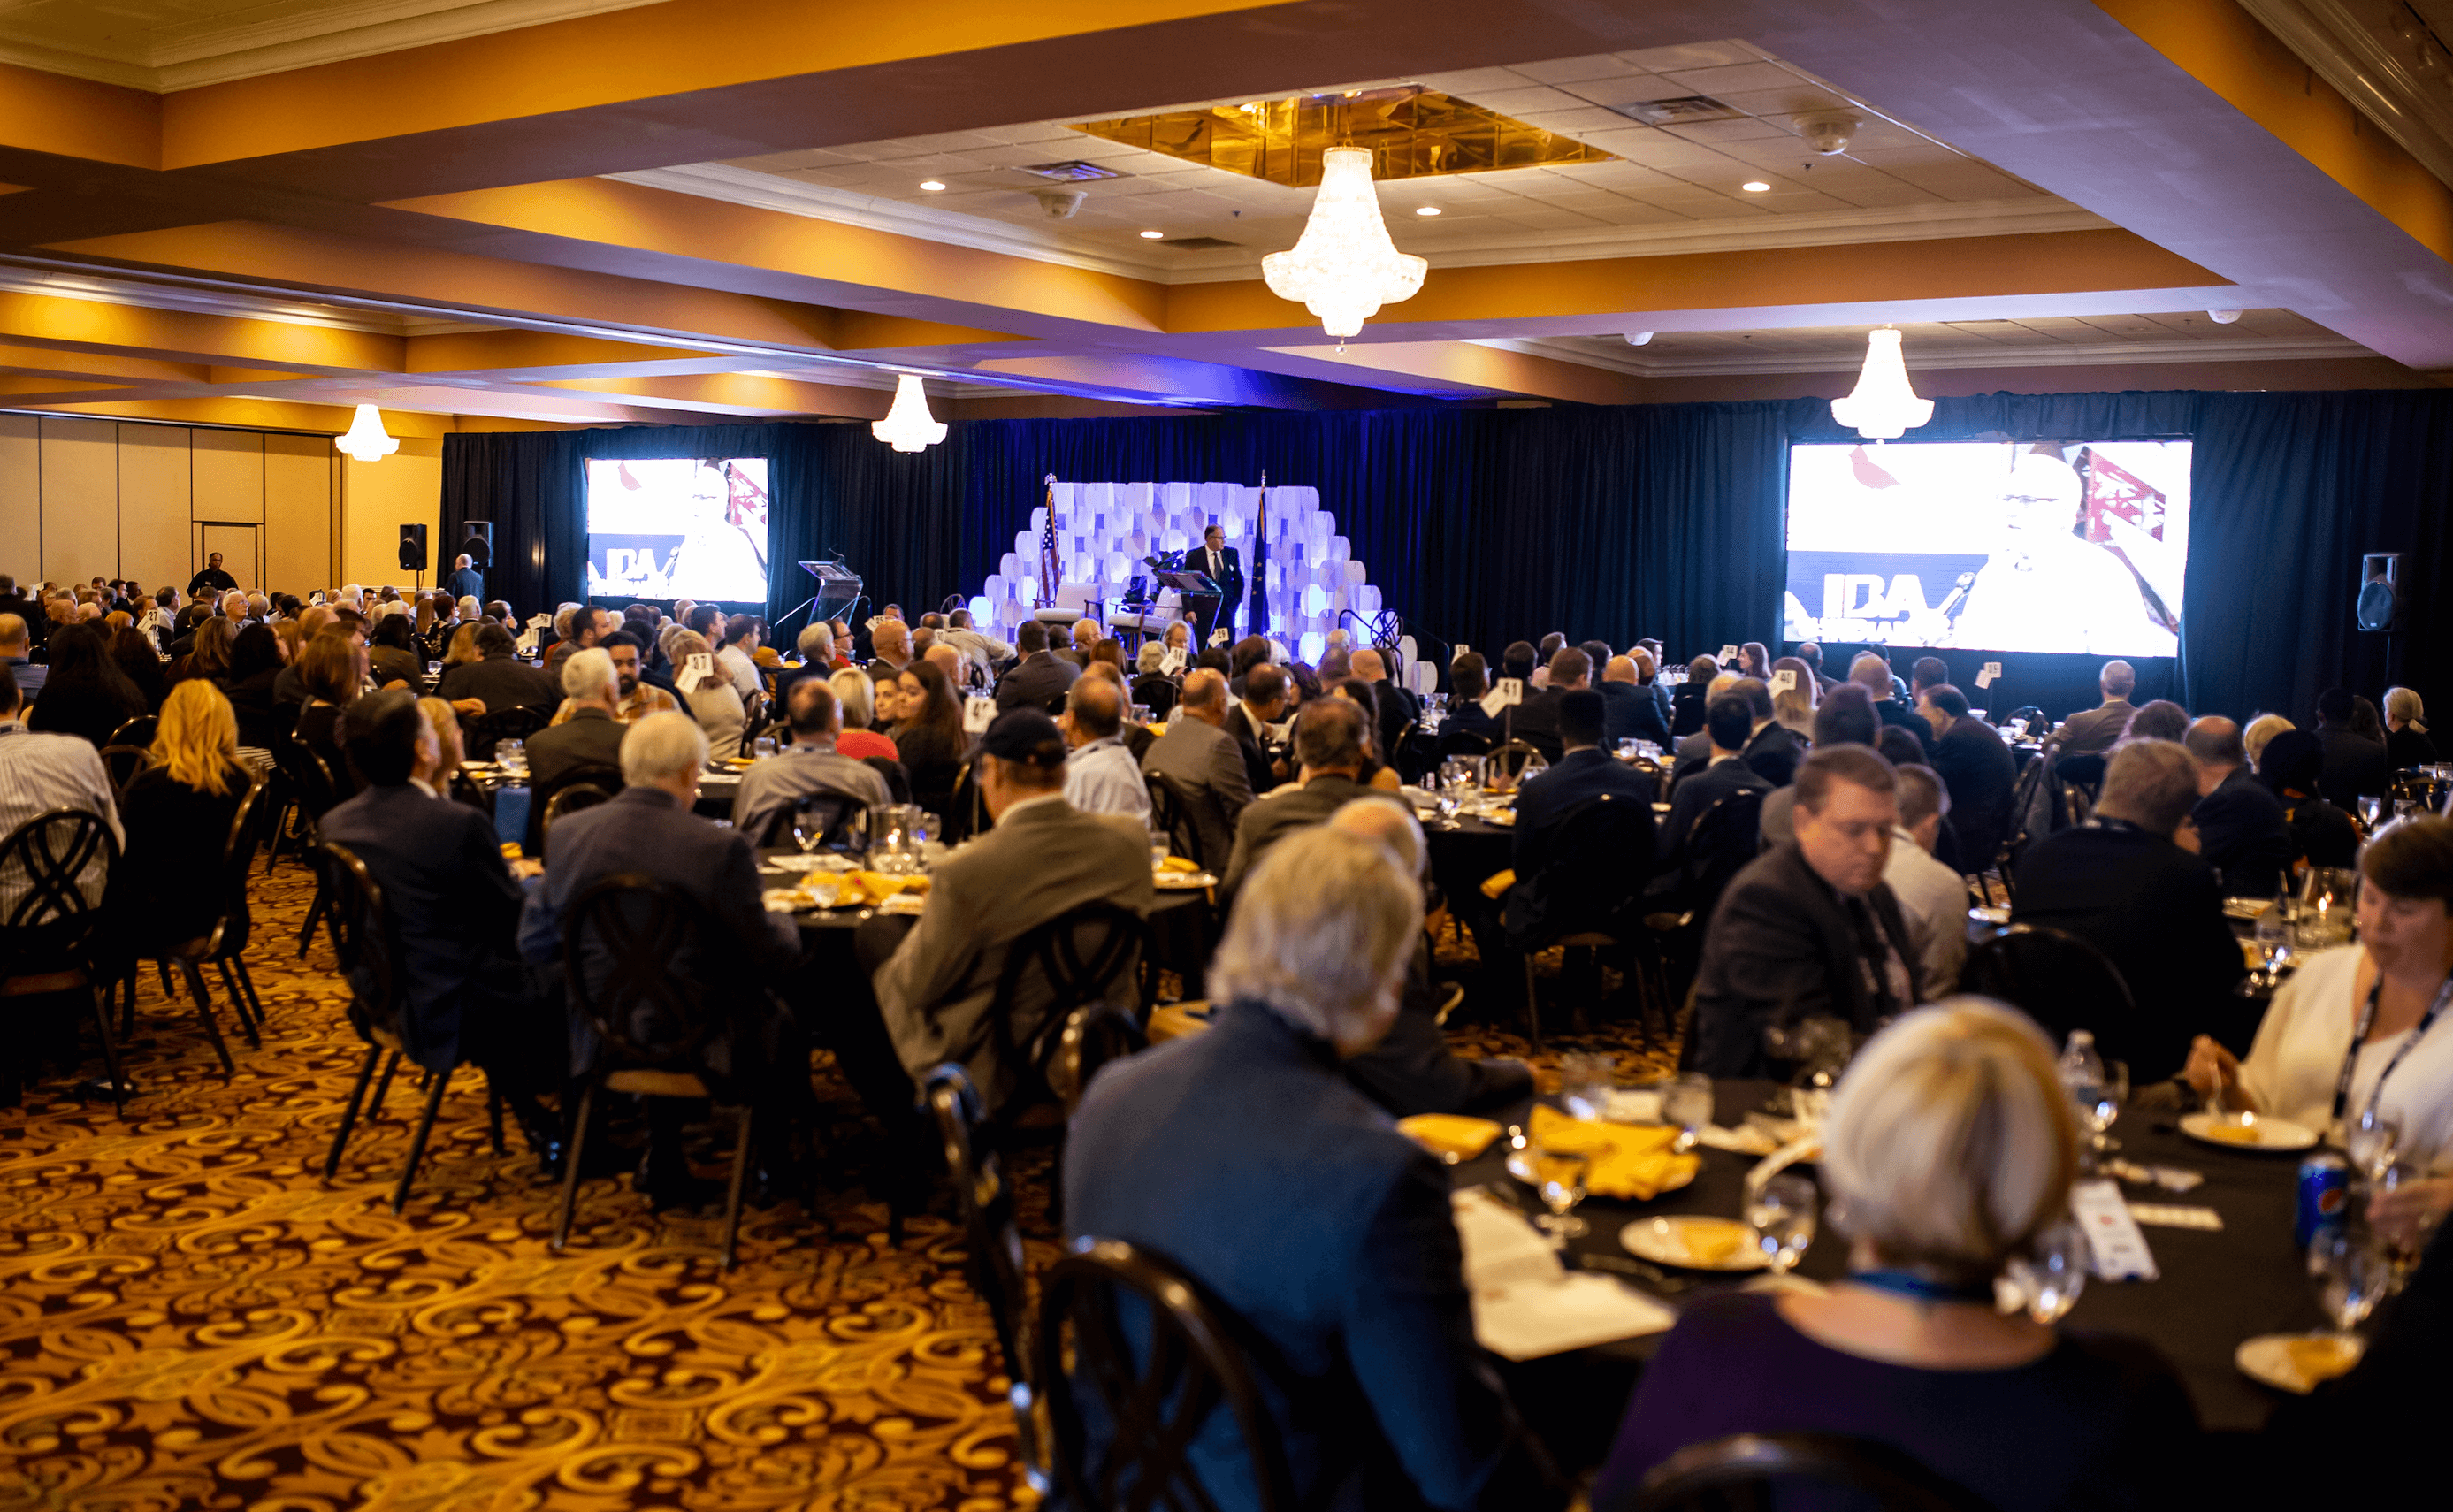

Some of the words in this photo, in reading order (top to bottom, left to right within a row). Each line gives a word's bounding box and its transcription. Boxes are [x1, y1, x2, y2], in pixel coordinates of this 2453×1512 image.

[149, 611, 157, 622] 27
[1217, 629, 1226, 638] 29
[1503, 682, 1518, 697] 41
